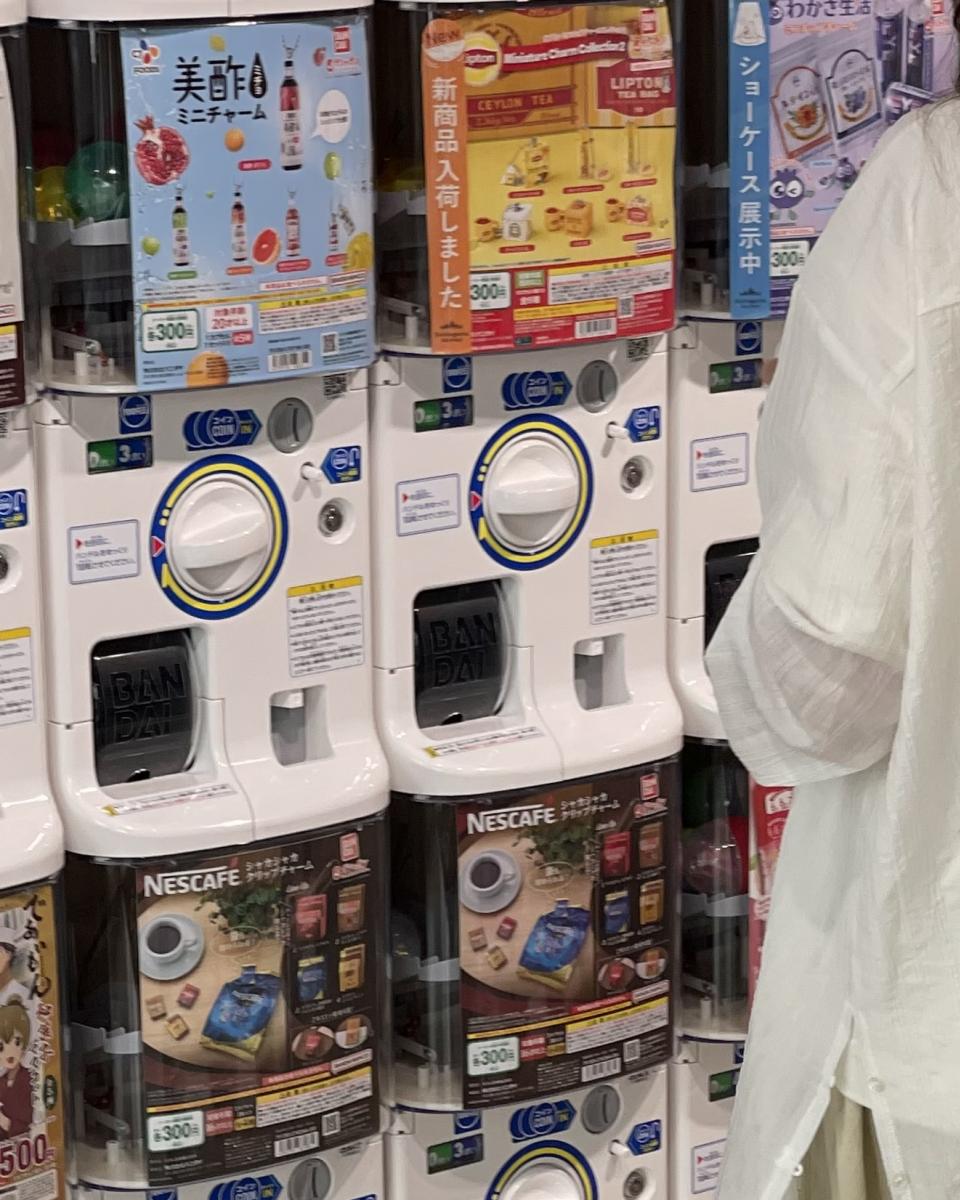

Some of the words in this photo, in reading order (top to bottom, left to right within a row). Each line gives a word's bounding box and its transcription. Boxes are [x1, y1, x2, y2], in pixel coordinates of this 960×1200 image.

[172, 54, 246, 103] 美酢
[610, 77, 665, 90] LIPTON
[177, 104, 268, 124] ミニチャーム
[478, 97, 522, 111] CEYLON
[532, 93, 553, 106] TEA
[157, 323, 186, 340] 300
[429, 611, 498, 653] BAN
[108, 663, 185, 707] BAN
[433, 653, 485, 689] DAI
[113, 708, 170, 745] DAI
[480, 1046, 508, 1065] 300
[162, 1122, 193, 1143] 300
[1, 1133, 47, 1177] 500
